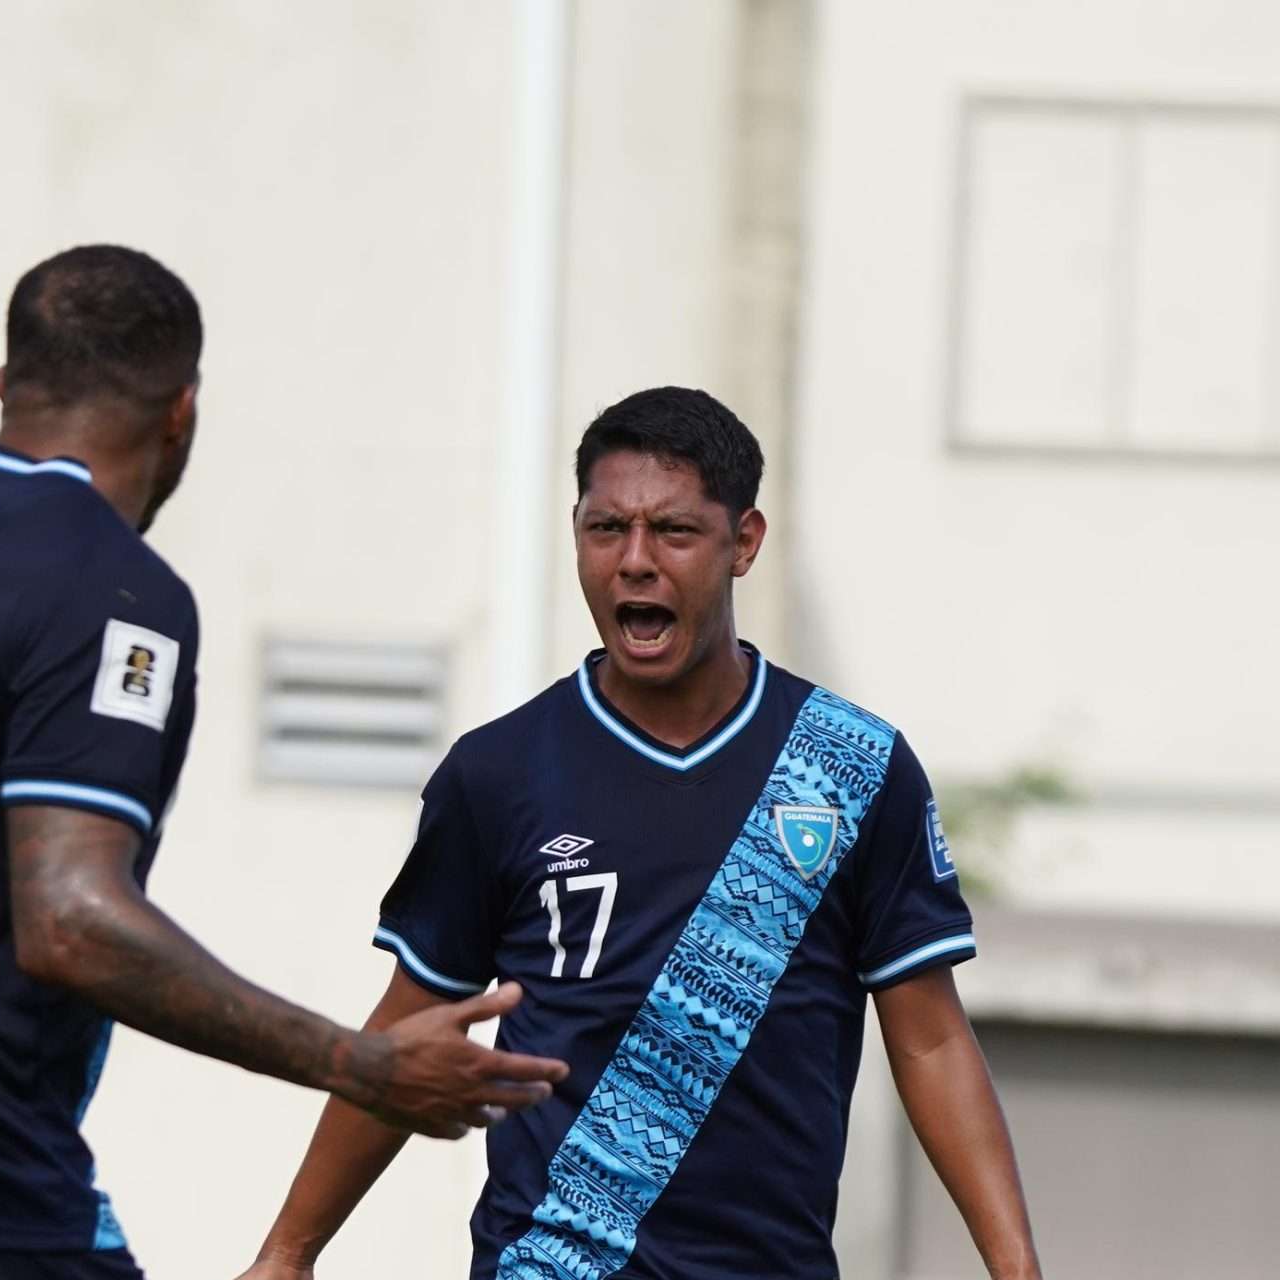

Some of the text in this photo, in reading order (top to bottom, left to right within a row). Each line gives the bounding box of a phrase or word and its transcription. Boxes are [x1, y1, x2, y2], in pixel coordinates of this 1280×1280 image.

[783, 812, 832, 824] GUATEMALA
[547, 857, 590, 873] umbro
[538, 872, 619, 979] 17
